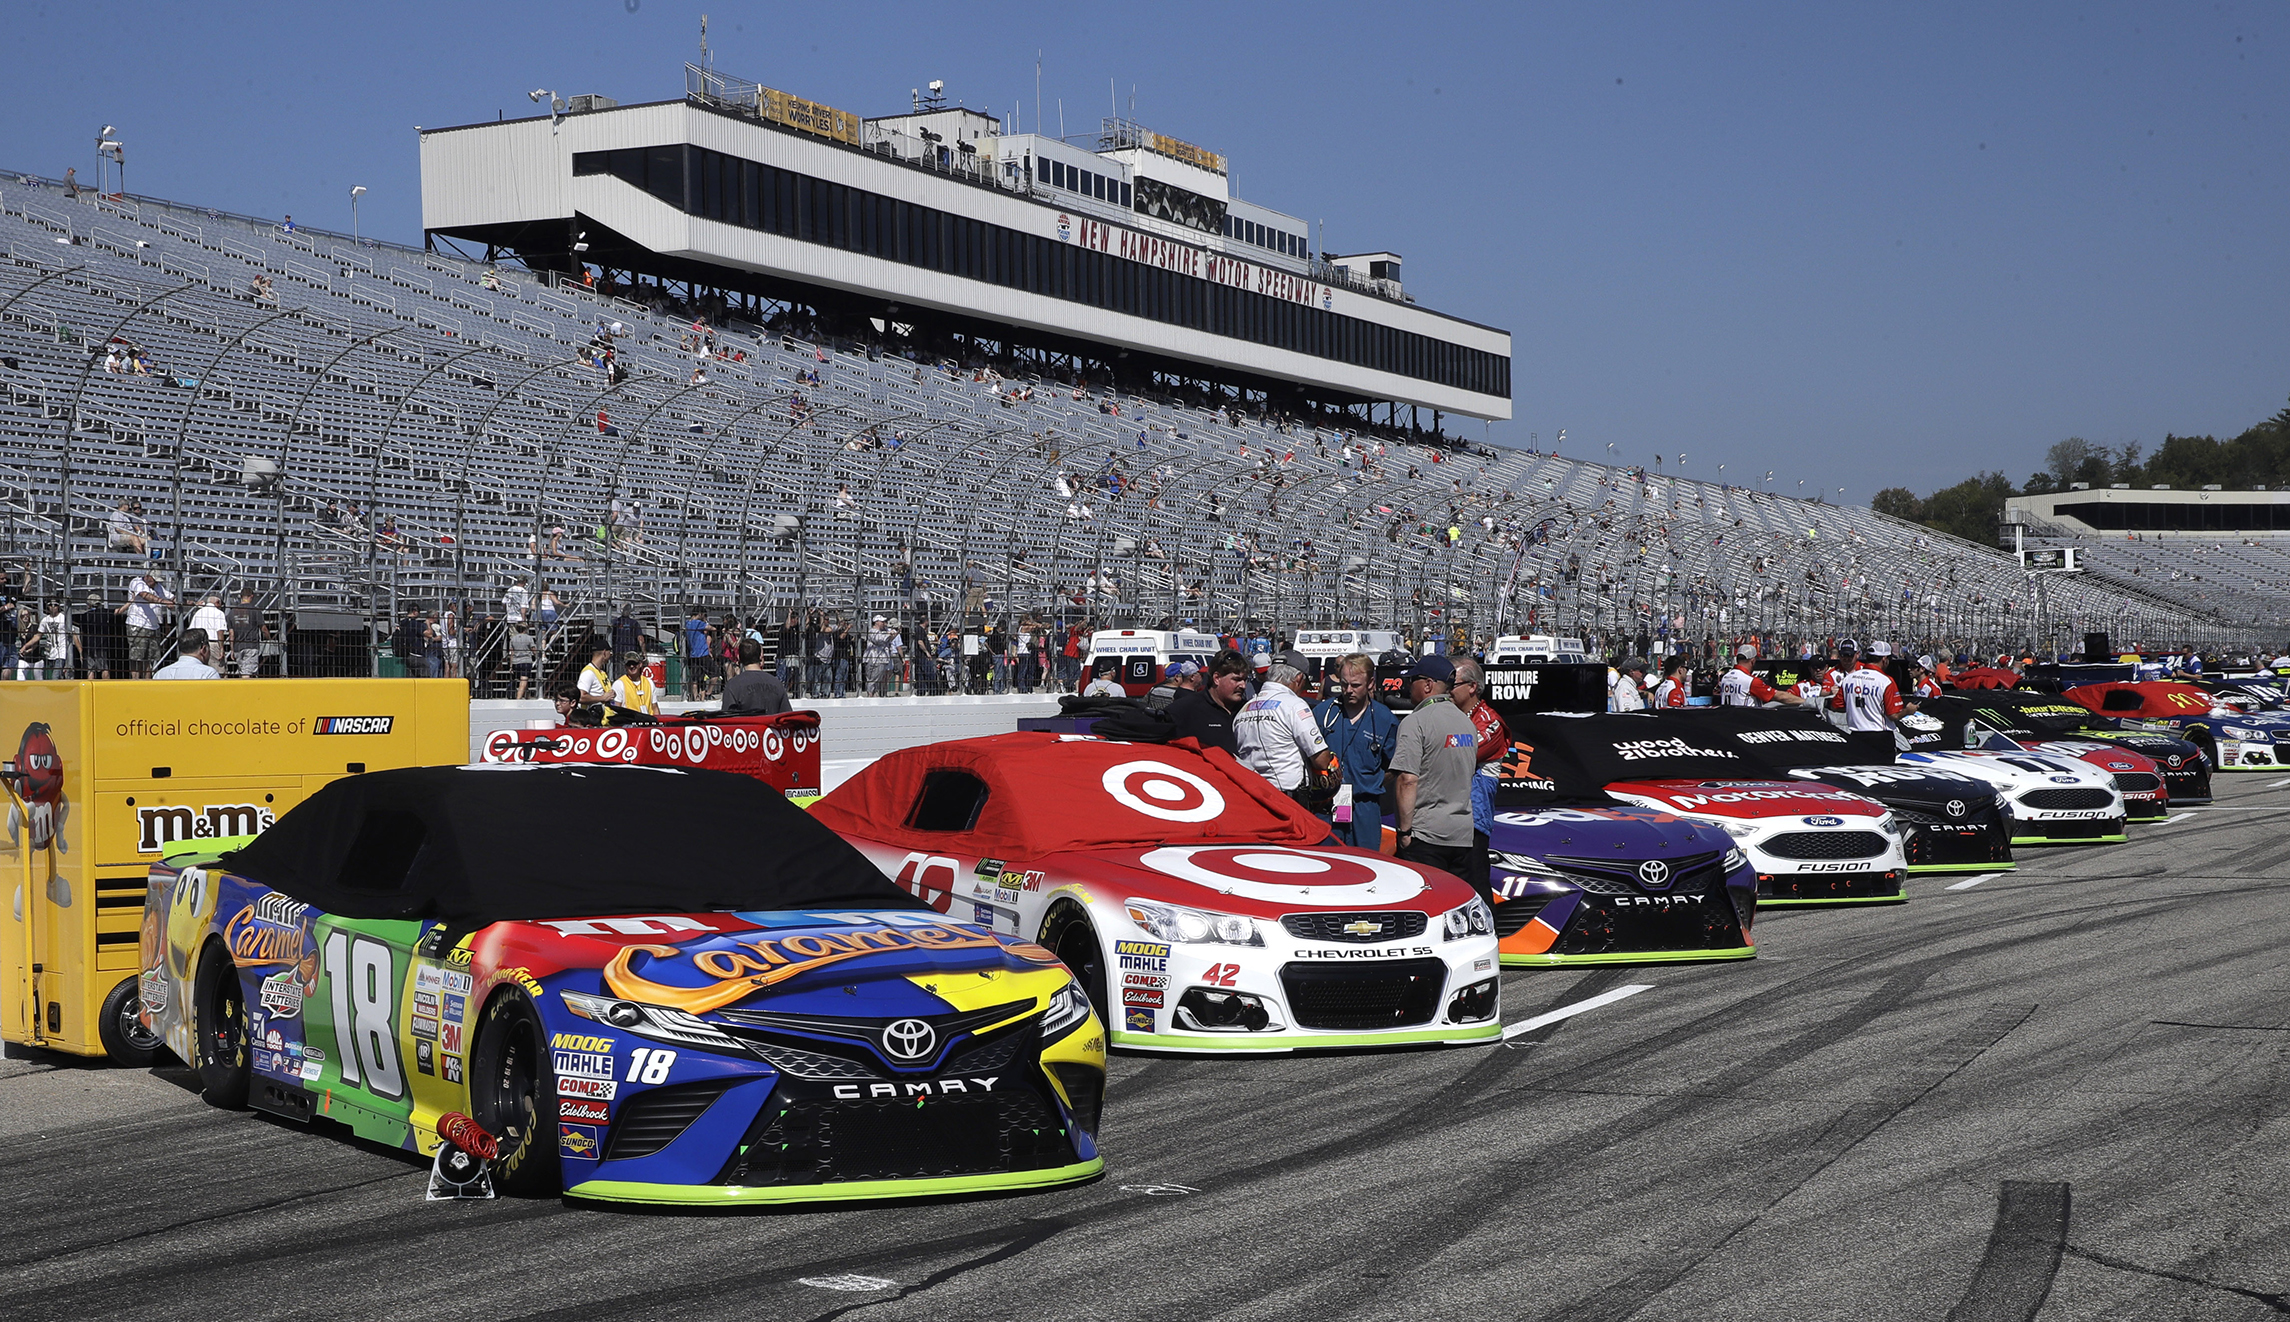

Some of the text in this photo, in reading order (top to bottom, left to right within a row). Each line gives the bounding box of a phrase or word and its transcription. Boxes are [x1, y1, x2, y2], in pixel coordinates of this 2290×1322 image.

[1080, 218, 1110, 253] NEW
[1121, 230, 1198, 276] HAMPSHIRE
[1208, 256, 1249, 289] MOTOR
[1258, 267, 1317, 307] SPEEDWAY
[2167, 656, 2183, 668] 24
[1485, 670, 1538, 685] FURNITURE
[1492, 685, 1531, 700] ROW
[1845, 683, 1879, 697] Mobil
[116, 717, 391, 736] official chocolate of NASCAR
[1444, 734, 1474, 748] AMR
[1612, 736, 1686, 750] wood
[1736, 730, 1793, 744] DENVER
[1811, 816, 1837, 826] Ford
[2038, 811, 2106, 819] FUSION
[1931, 824, 1988, 832] CAMRY
[1797, 862, 1871, 872] FUSION
[1023, 872, 1044, 892] 3M
[1501, 876, 1530, 897] 11
[994, 888, 1012, 901] Mobil
[1614, 894, 1705, 907] CAMRY
[224, 904, 308, 965] Caramel
[1117, 941, 1169, 956] MOOG
[1294, 946, 1433, 959] CHEVROLET SS
[603, 922, 1000, 1015] Caramel
[1120, 956, 1166, 971] MAHLE
[443, 971, 463, 988] Mobil
[1125, 974, 1158, 985] COMP
[1201, 963, 1240, 986] 42
[142, 977, 167, 993] INTERSTATE
[264, 981, 302, 997] INTERSTATE
[487, 967, 544, 998] GOODYEAR
[142, 989, 166, 1003] BATTERIES
[264, 993, 300, 1008] BATTERIES
[1125, 990, 1162, 1005] Edelbrock
[324, 928, 404, 1102] 18
[1129, 1016, 1153, 1025] SUNOCO
[266, 1030, 282, 1044] MAC
[442, 1024, 461, 1053] 3M
[550, 1033, 615, 1053] MOOG
[554, 1053, 613, 1074] MAHLE
[625, 1047, 677, 1085] 18
[559, 1079, 600, 1093] COMP
[833, 1077, 999, 1099] CAMRY
[559, 1102, 608, 1121] Edelbrock
[560, 1137, 595, 1148] SUNOCO
